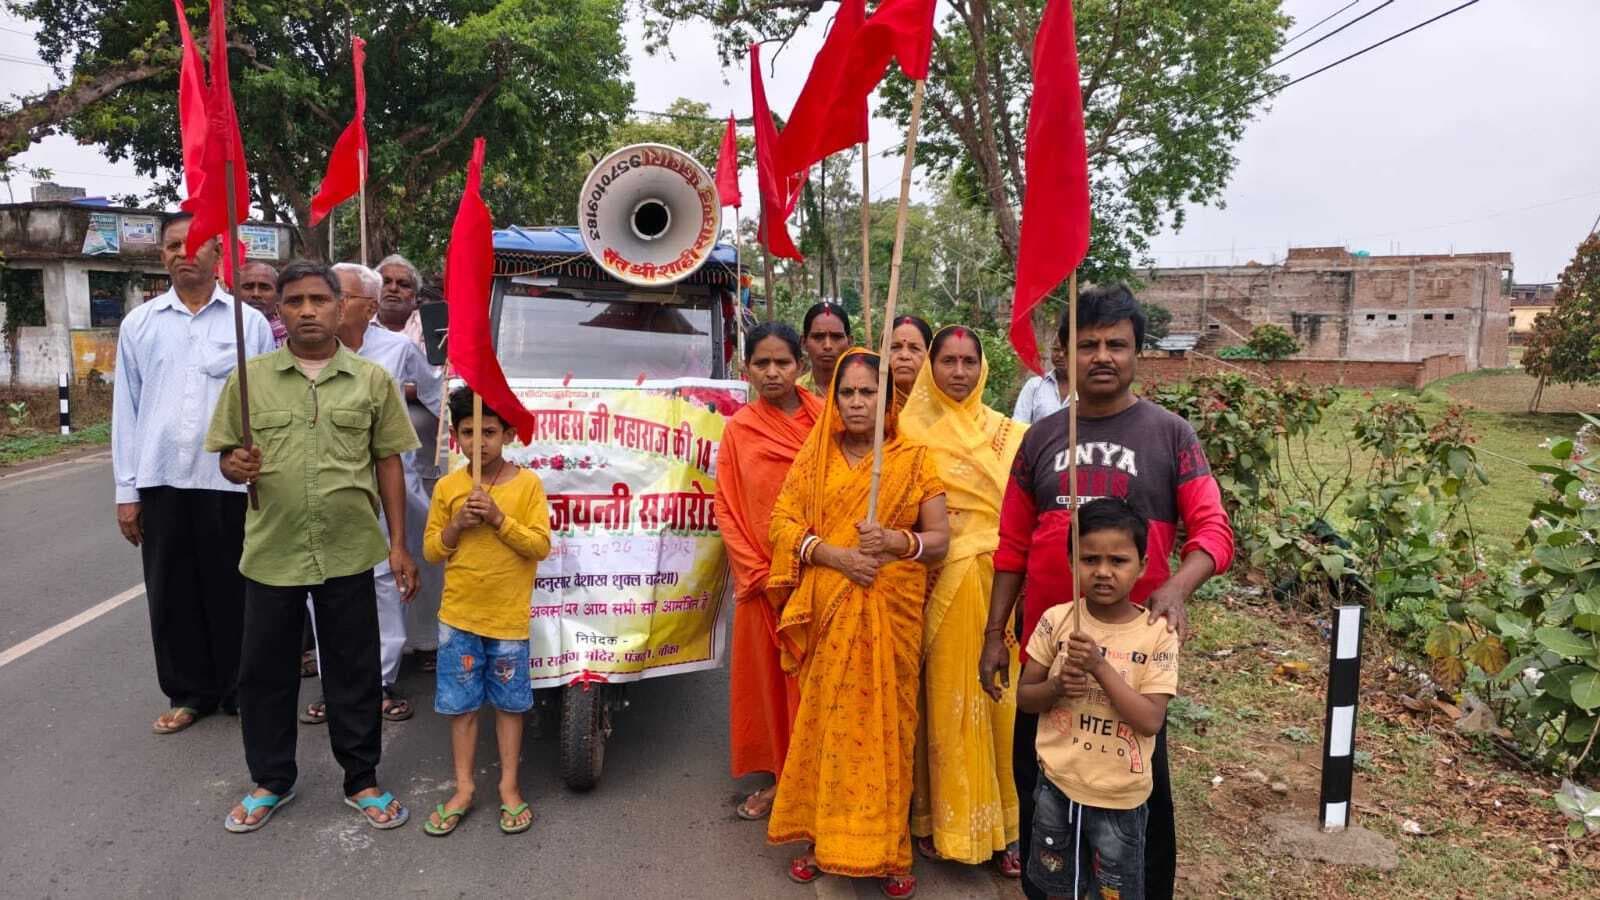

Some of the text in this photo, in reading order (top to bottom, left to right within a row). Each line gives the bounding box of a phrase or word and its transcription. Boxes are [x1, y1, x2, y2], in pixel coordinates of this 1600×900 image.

[586, 154, 641, 241] 9570109183
[589, 403, 609, 444] जी
[614, 415, 671, 457] महाराज
[673, 421, 693, 465] की
[547, 482, 633, 532] जयन्ती
[612, 574, 641, 590] शुक्ल
[565, 603, 578, 616] पर
[583, 603, 608, 615] आप
[612, 598, 636, 615] सभी
[575, 632, 618, 646] निवेदक
[1080, 714, 1113, 735] HTE
[1072, 737, 1126, 757] POLO
